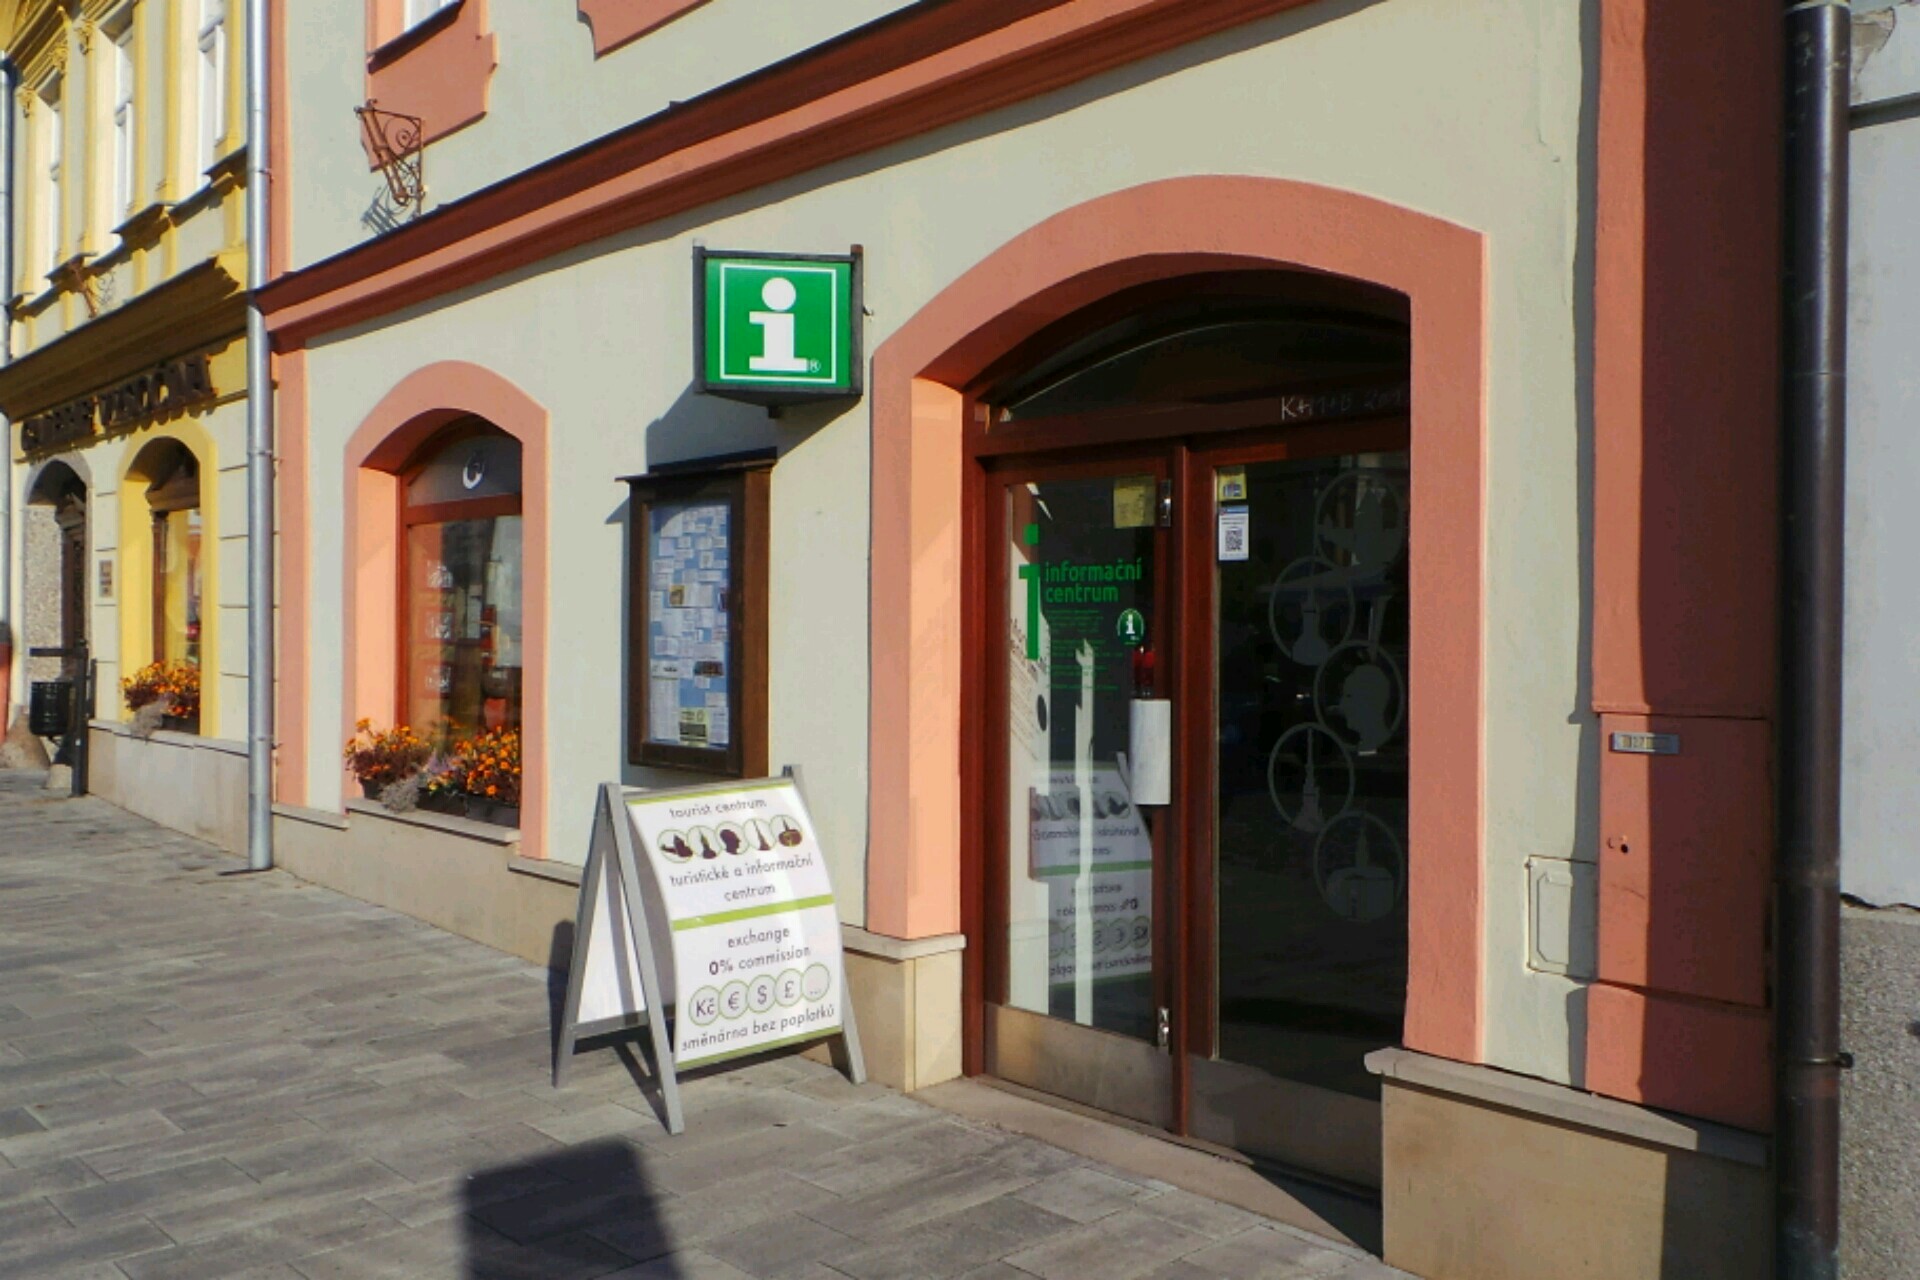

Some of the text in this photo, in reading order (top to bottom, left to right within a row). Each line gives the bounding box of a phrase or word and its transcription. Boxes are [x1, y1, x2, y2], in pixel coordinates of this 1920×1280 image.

[1045, 558, 1142, 582] informační
[1045, 584, 1119, 603] centrum
[669, 799, 767, 818] tourist centrum
[669, 853, 813, 886] turistické a informační
[724, 884, 776, 902] centrum
[728, 927, 790, 948] exchange
[709, 945, 812, 976] 0% commission
[695, 997, 716, 1018] Kč
[728, 990, 740, 1011] €
[784, 980, 795, 999] £
[681, 1004, 835, 1051] směnárna bez poplatků
